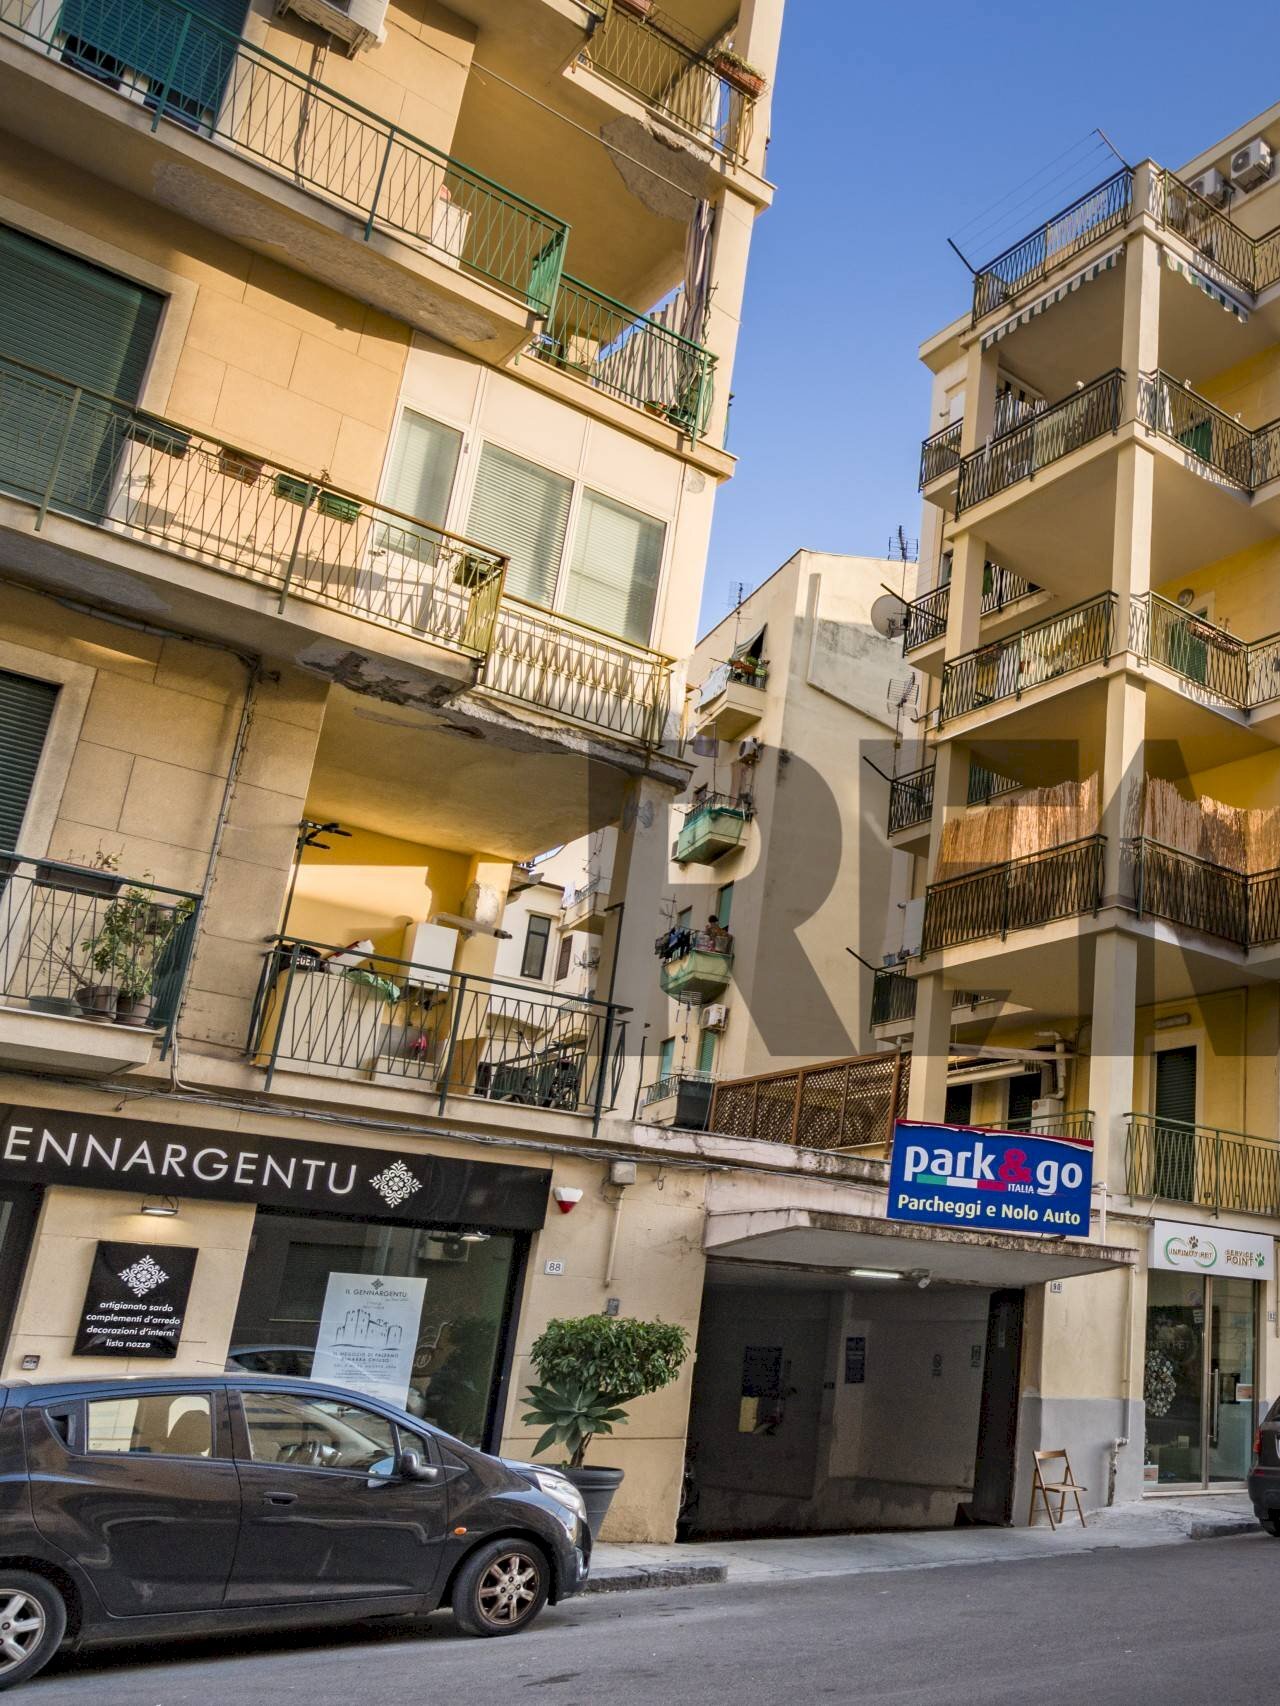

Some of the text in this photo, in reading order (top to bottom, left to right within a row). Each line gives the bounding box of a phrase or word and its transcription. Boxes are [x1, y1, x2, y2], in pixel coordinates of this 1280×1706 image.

[1007, 1182, 1034, 1194] ITALIA
[897, 1194, 1081, 1225] Parcheggi e Nolo Auto
[1226, 1256, 1255, 1266] POINT
[548, 1262, 561, 1271] 88
[100, 1301, 173, 1312] artigianato sardo
[86, 1313, 142, 1322] complementi
[86, 1325, 138, 1335] decorazioni
[106, 1338, 124, 1347] lista
